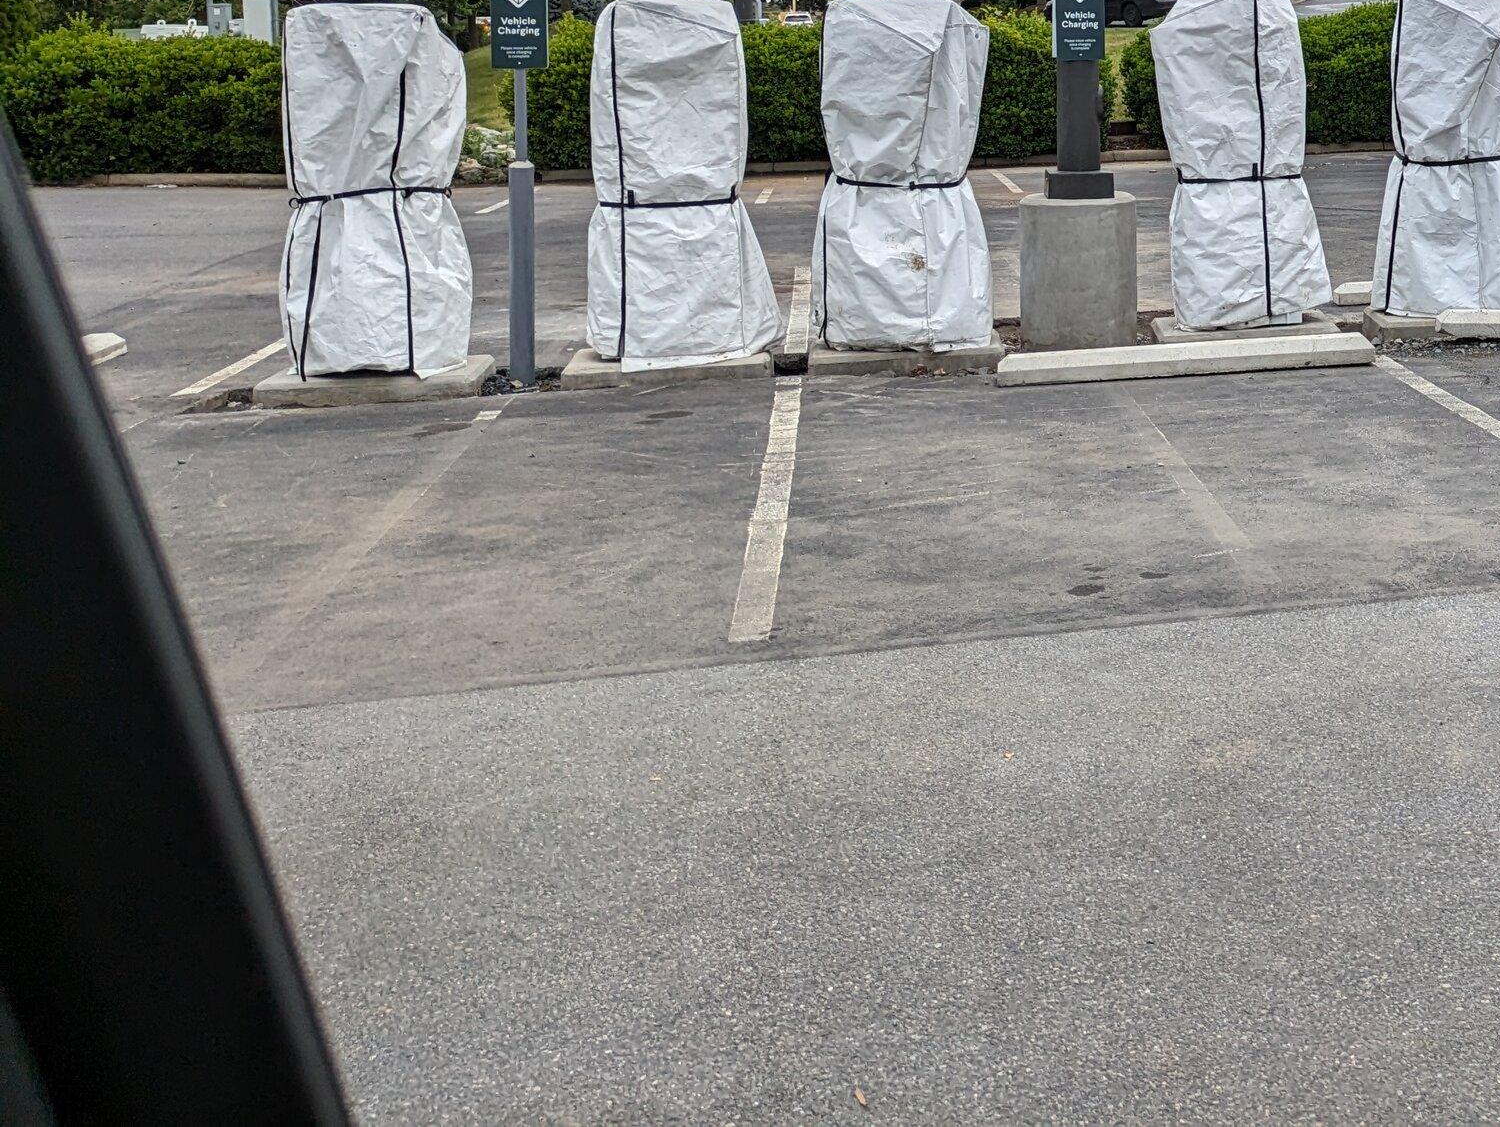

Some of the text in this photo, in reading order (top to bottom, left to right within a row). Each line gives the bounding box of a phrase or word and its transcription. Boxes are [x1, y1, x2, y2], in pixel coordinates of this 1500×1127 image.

[1064, 11, 1096, 19] Vehicle
[500, 16, 536, 25] Vehicle
[1061, 20, 1099, 30] Charging
[498, 26, 540, 37] Charging
